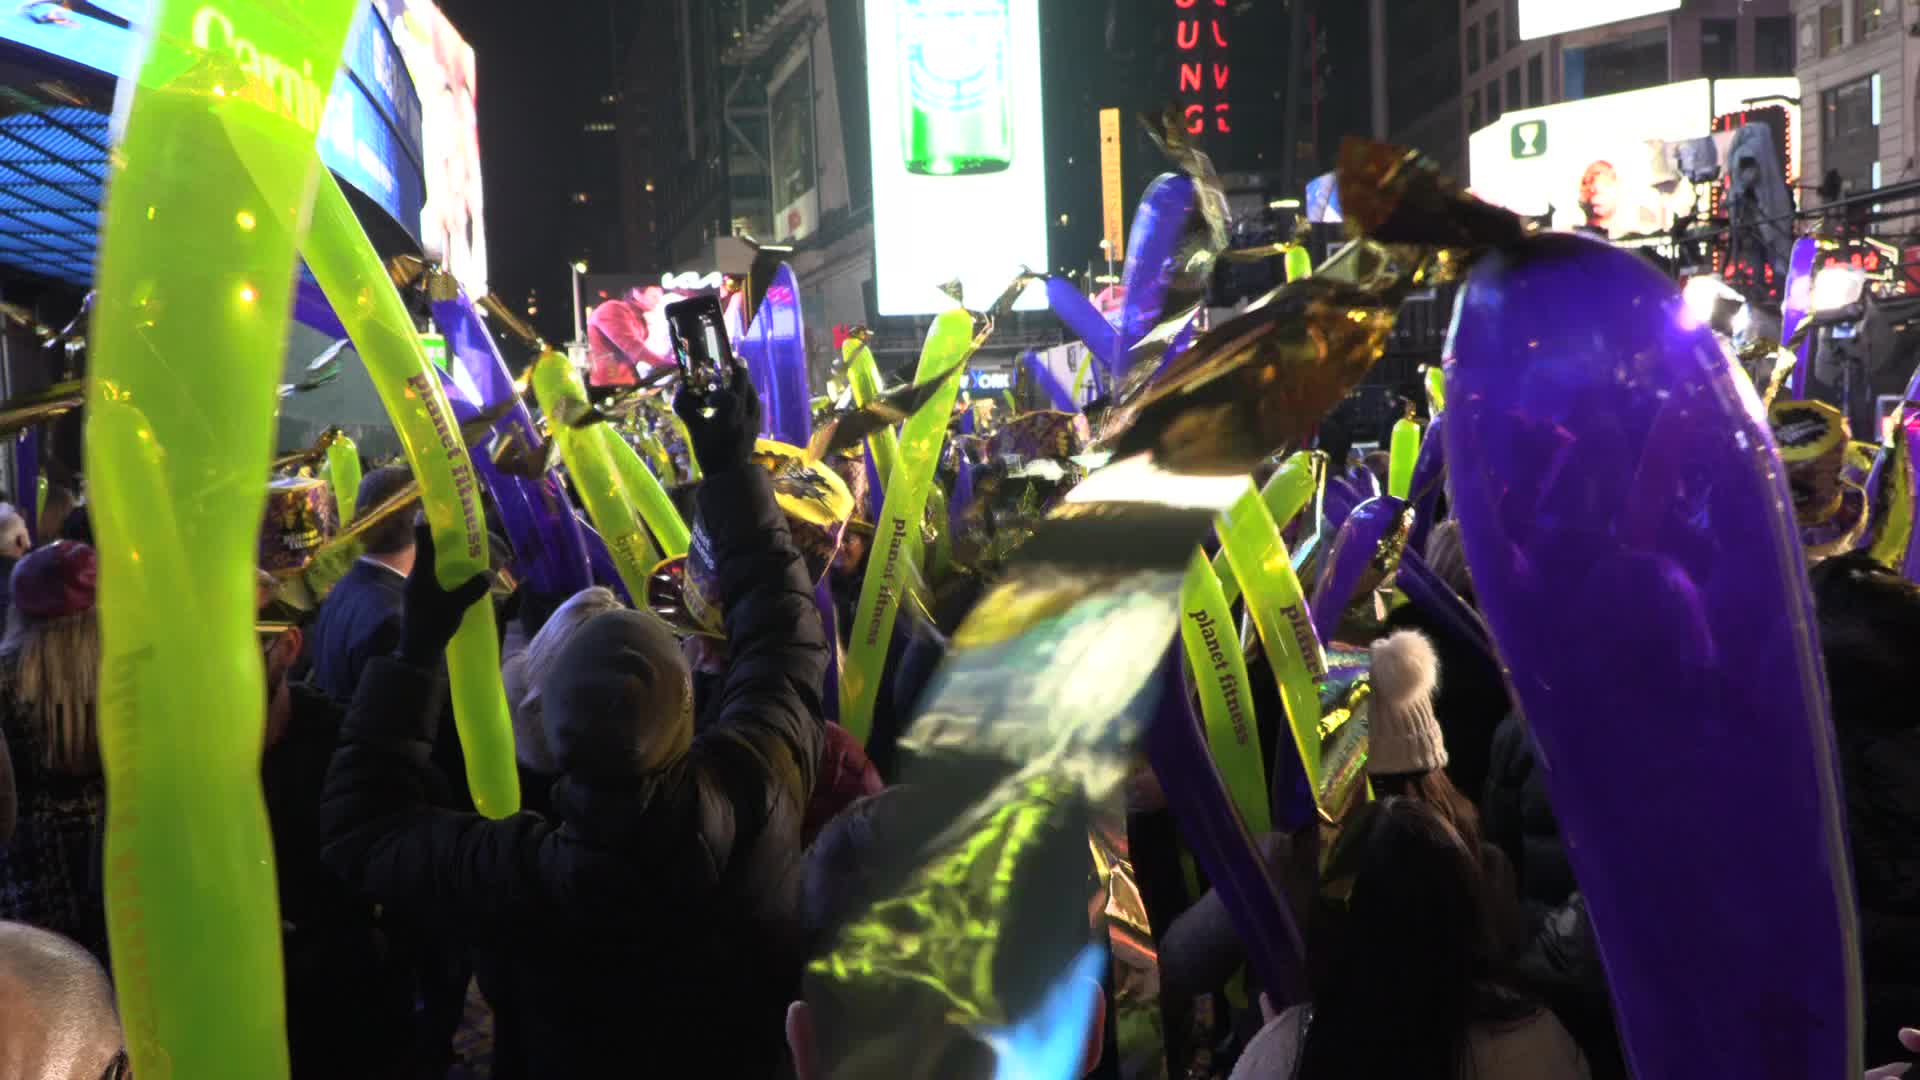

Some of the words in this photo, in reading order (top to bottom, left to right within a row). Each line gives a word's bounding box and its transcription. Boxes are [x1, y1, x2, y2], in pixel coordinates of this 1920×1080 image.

[1175, 0, 1204, 135] UNG
[407, 372, 461, 460] planet
[970, 369, 1009, 389] YORK
[880, 517, 906, 579] planet
[1188, 608, 1228, 671] planet
[1218, 674, 1248, 741] fitness
